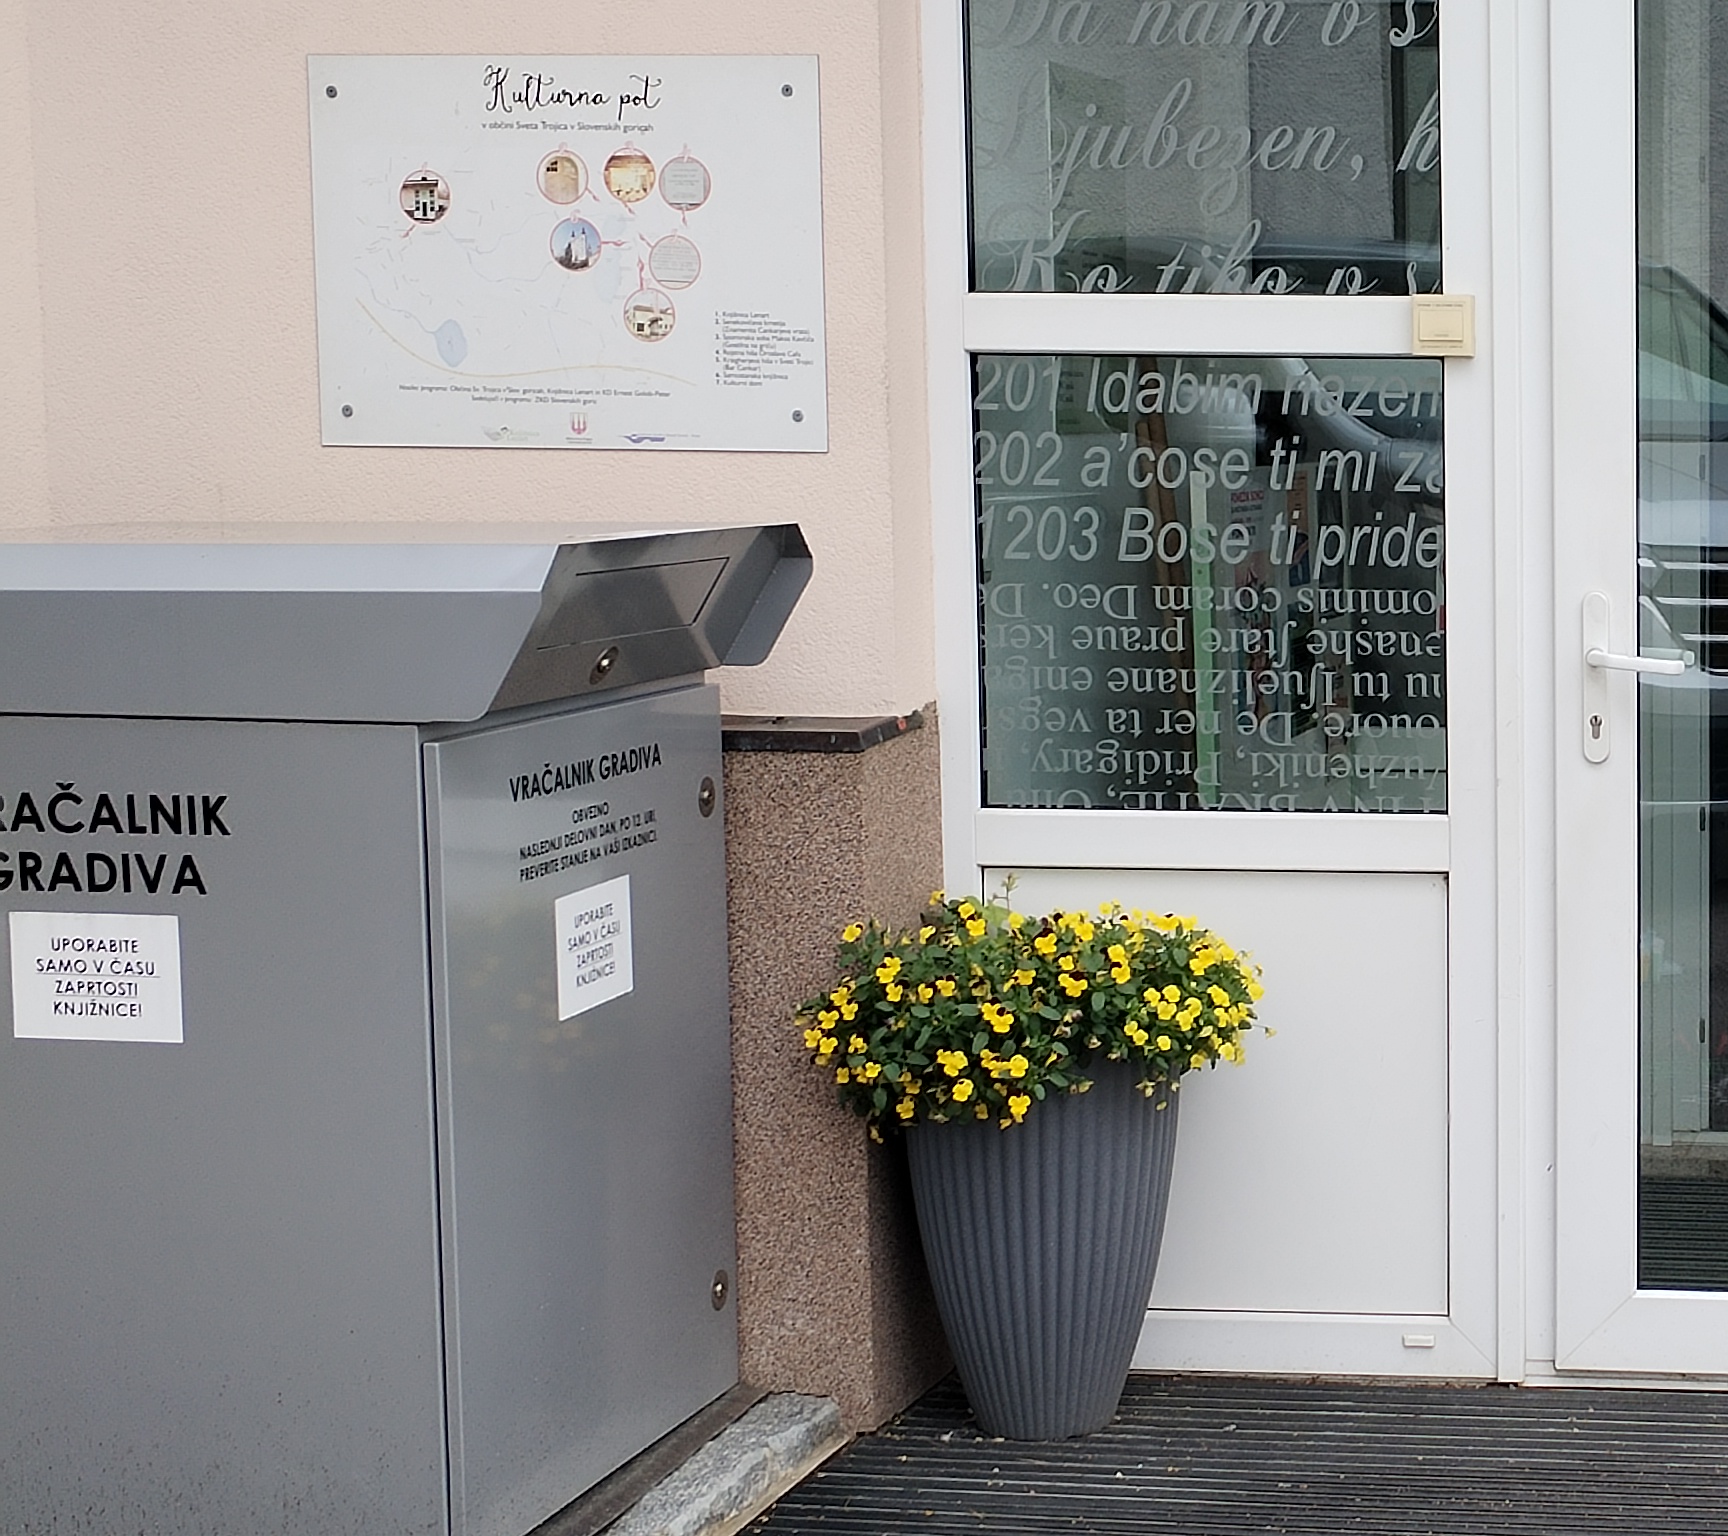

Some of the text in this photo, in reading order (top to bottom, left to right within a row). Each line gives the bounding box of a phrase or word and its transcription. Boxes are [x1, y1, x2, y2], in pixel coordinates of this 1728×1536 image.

[483, 65, 662, 121] Kulturna pot
[516, 121, 538, 130] Sveta
[541, 121, 568, 132] Trojica
[577, 122, 621, 131] Slovenskih
[1269, 437, 1301, 491] ti
[1119, 506, 1251, 564] Bose
[1269, 510, 1301, 565] ti
[1041, 583, 1138, 619] Deo.
[1152, 586, 1282, 613] coram
[1071, 616, 1185, 653] praue
[1351, 672, 1391, 703] tu
[1105, 707, 1143, 738] ta
[1235, 711, 1295, 746] De
[509, 743, 662, 802] VRAČALNIK GRADIVA
[0, 782, 231, 835] AČALNIK
[572, 802, 609, 824] OBVEZNO
[519, 835, 562, 860] NASLEDNJI
[564, 826, 598, 847] DELOVNI
[620, 816, 630, 830] PO
[520, 858, 559, 882] PREVERITE
[561, 849, 588, 870] STANJE
[590, 847, 602, 860] NA
[51, 938, 139, 953] UPORABITE
[36, 957, 155, 975] SAMO V ČASU
[55, 980, 138, 996] ZAPRTOSTI
[53, 999, 142, 1017] KNJIŽNICE!
